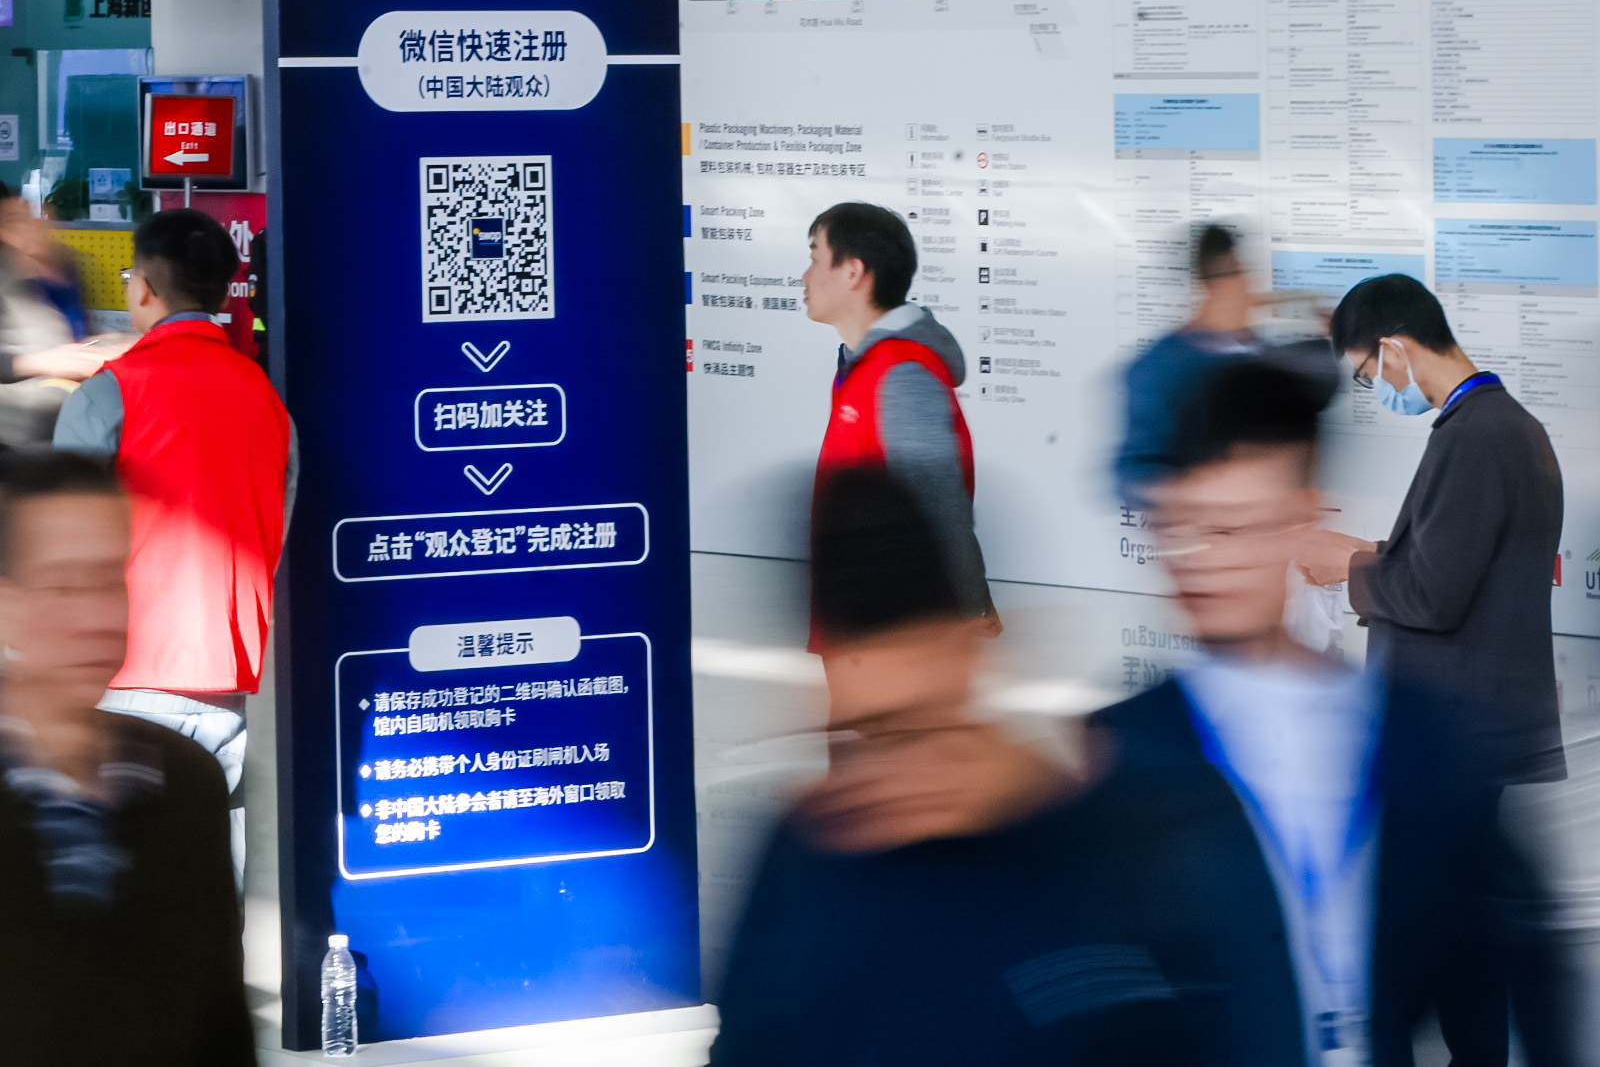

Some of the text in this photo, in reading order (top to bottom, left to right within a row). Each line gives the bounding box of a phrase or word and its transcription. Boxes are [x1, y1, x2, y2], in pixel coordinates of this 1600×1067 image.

[398, 28, 568, 63] 微信快速注册
[181, 141, 199, 151] Exit
[433, 398, 549, 431] 扫码加关注
[367, 521, 617, 563] 点击“观众登记”完成注册
[456, 631, 534, 659] 温馨提示
[372, 707, 517, 737] 馆内自助机领取胸卡
